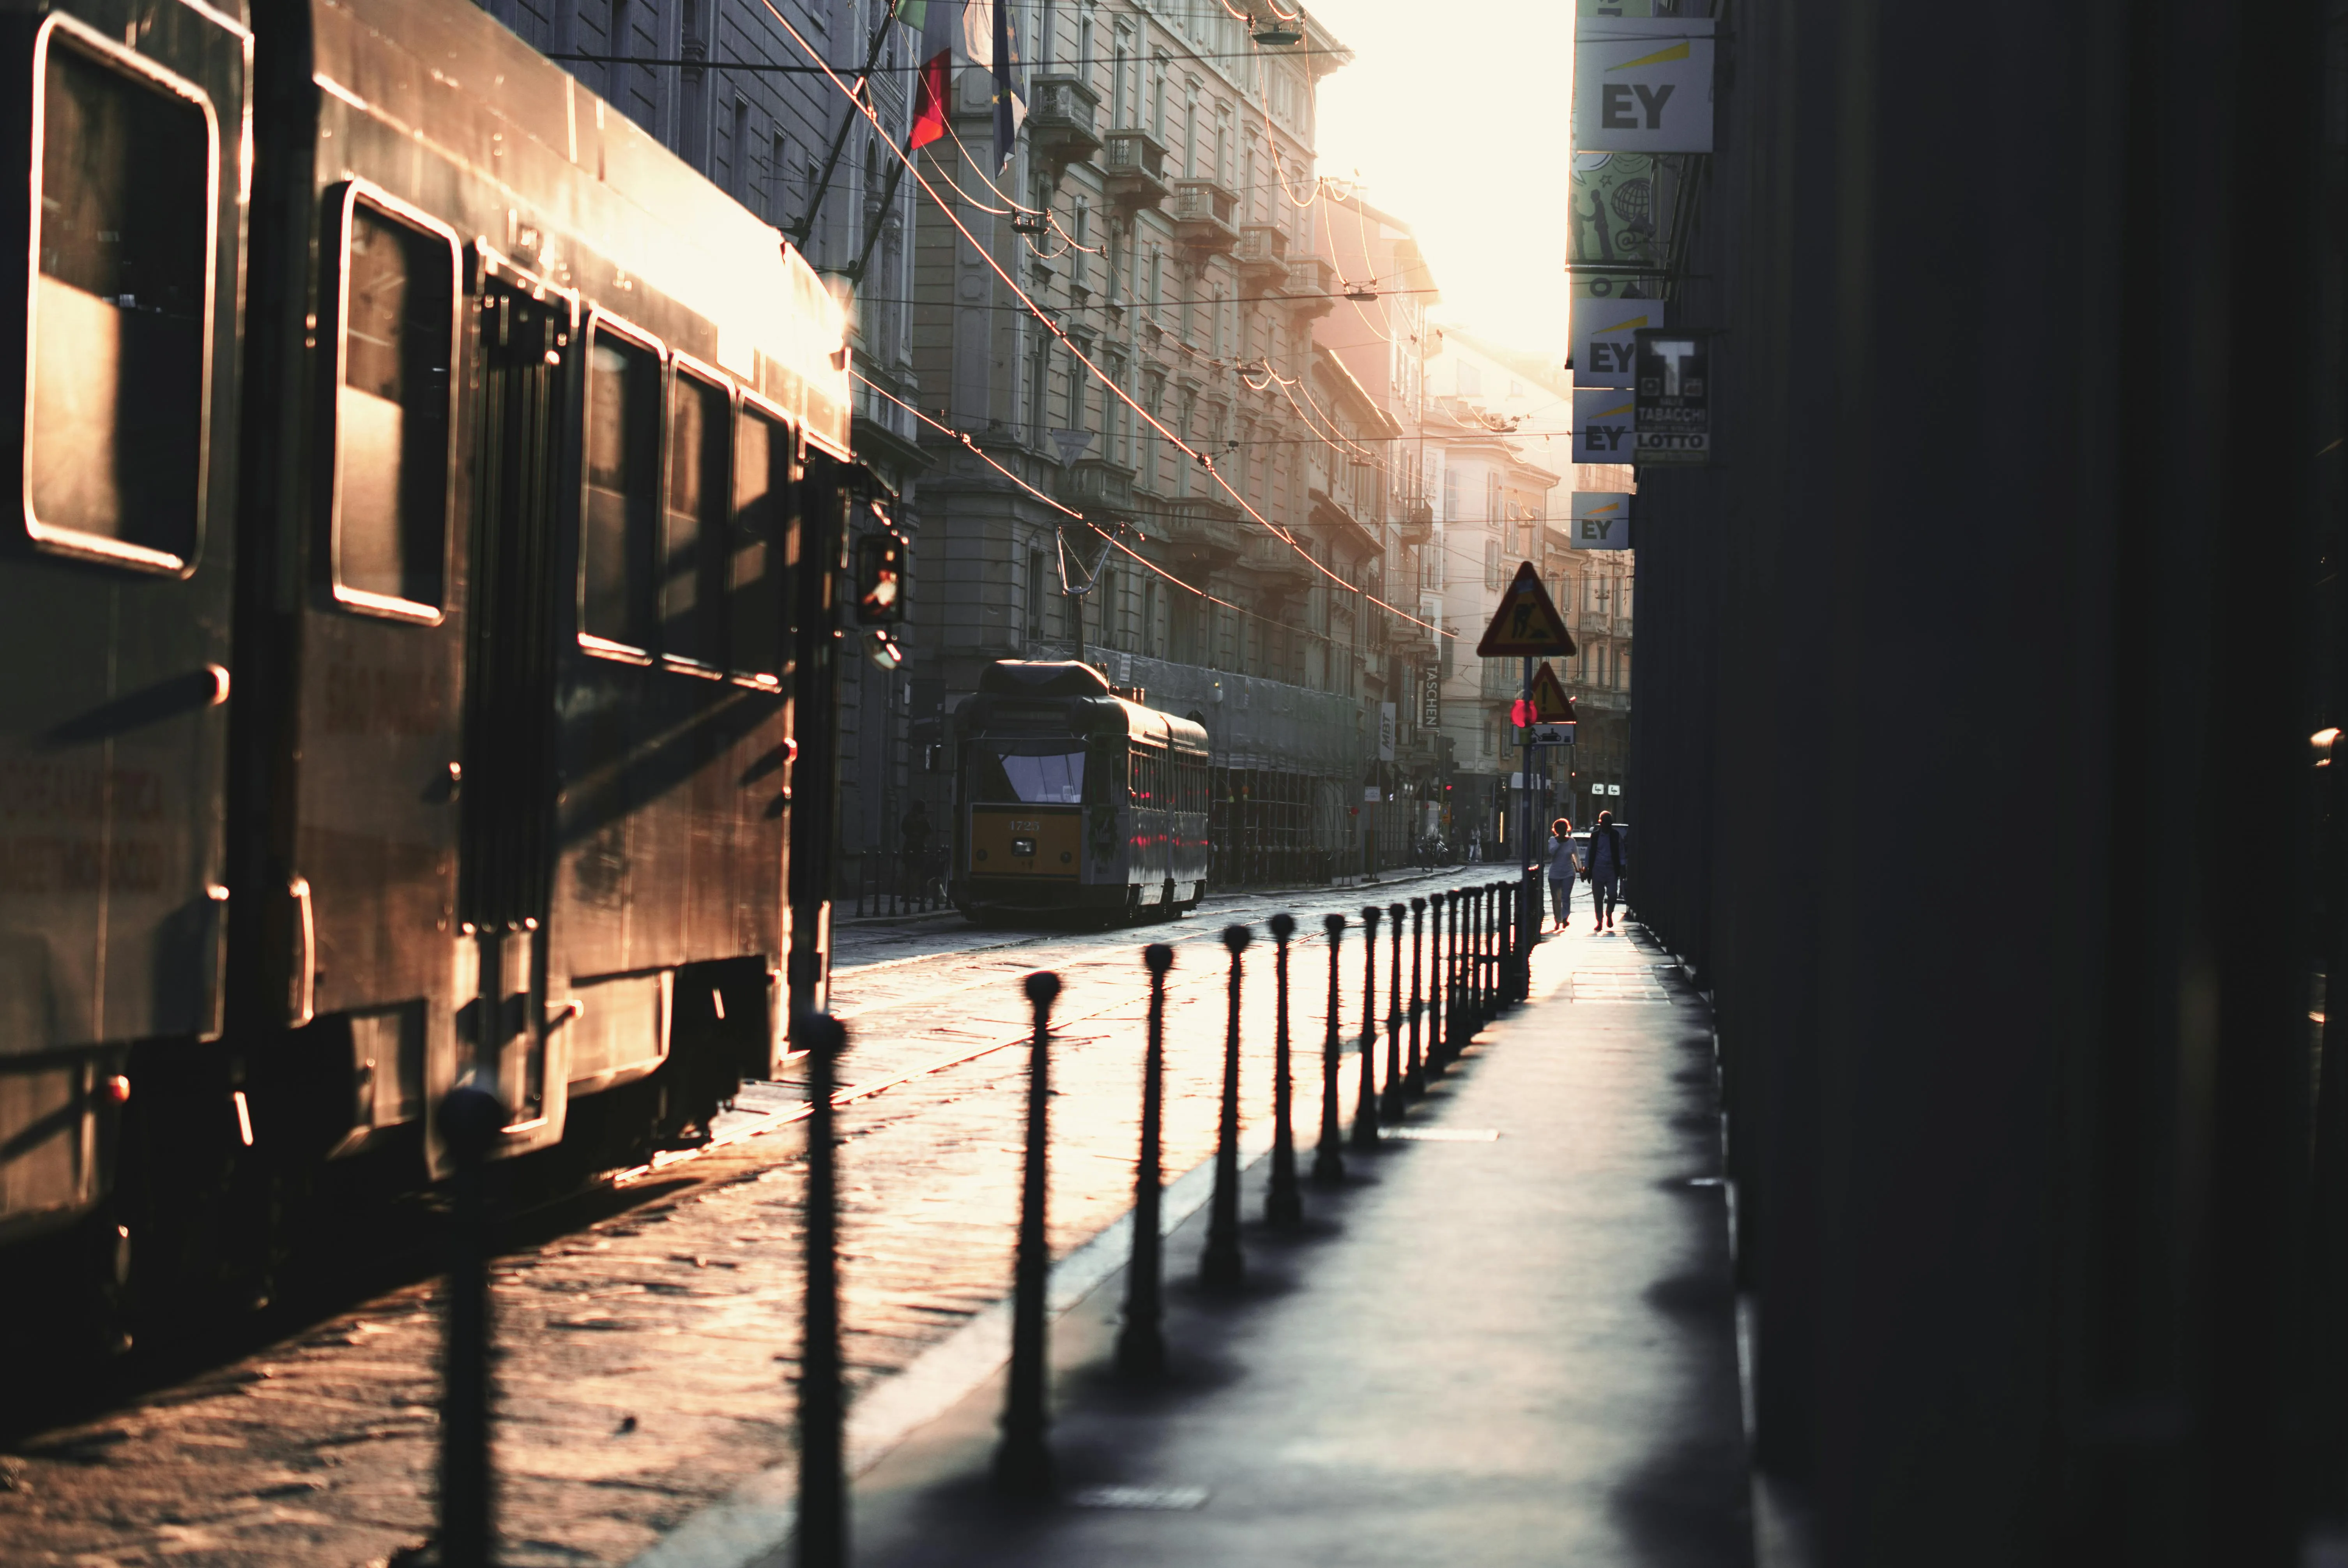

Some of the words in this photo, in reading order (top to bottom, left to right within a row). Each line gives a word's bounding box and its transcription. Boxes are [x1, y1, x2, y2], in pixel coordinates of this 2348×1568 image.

[1602, 84, 1675, 129] EY
[1589, 343, 1634, 373] EY
[1651, 341, 1694, 396] T
[1637, 407, 1706, 422] TABACCHI
[1586, 426, 1625, 450] EY
[1637, 434, 1703, 448] LOTTO
[1581, 520, 1612, 540] EY
[1426, 666, 1437, 725] TASCHEN
[1382, 713, 1390, 749] MBT
